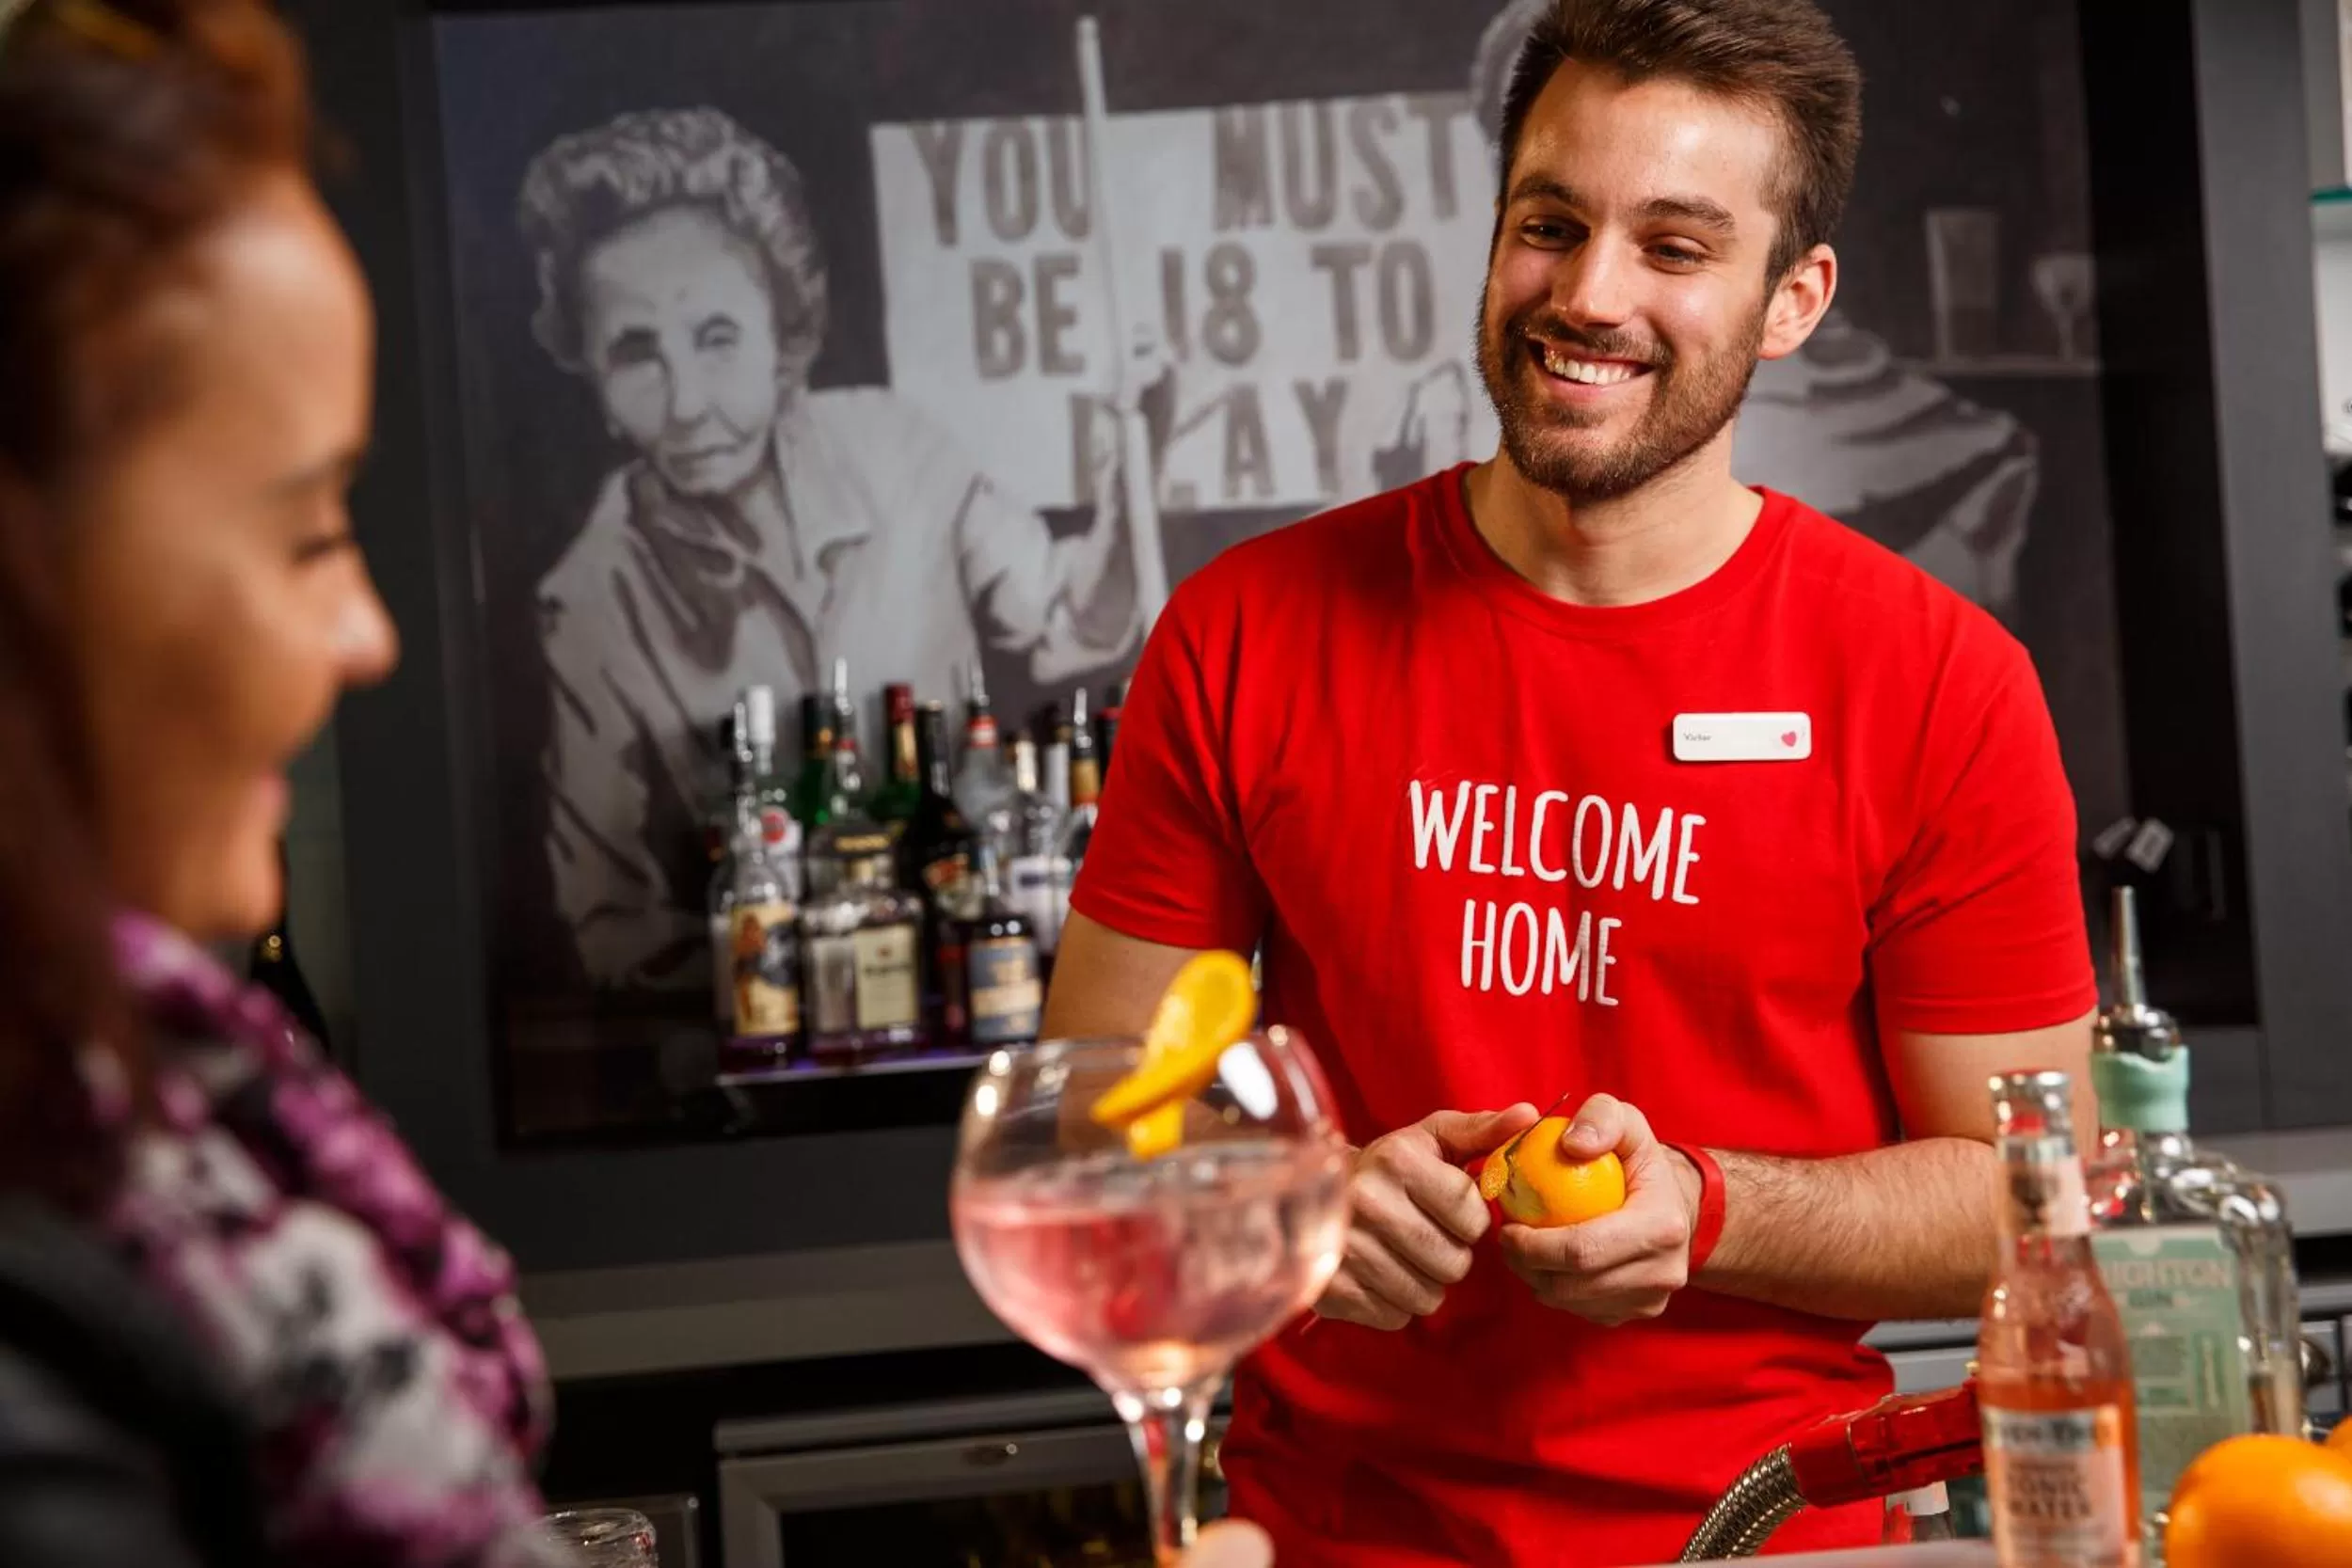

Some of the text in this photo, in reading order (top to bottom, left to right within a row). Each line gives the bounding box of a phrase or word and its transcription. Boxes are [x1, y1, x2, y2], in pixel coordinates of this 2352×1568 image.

[910, 94, 1470, 246] YOU MUST
[969, 241, 1435, 380] BE 18 TO
[1410, 780, 1706, 904] WELCOME
[1461, 898, 1622, 1006] HOME
